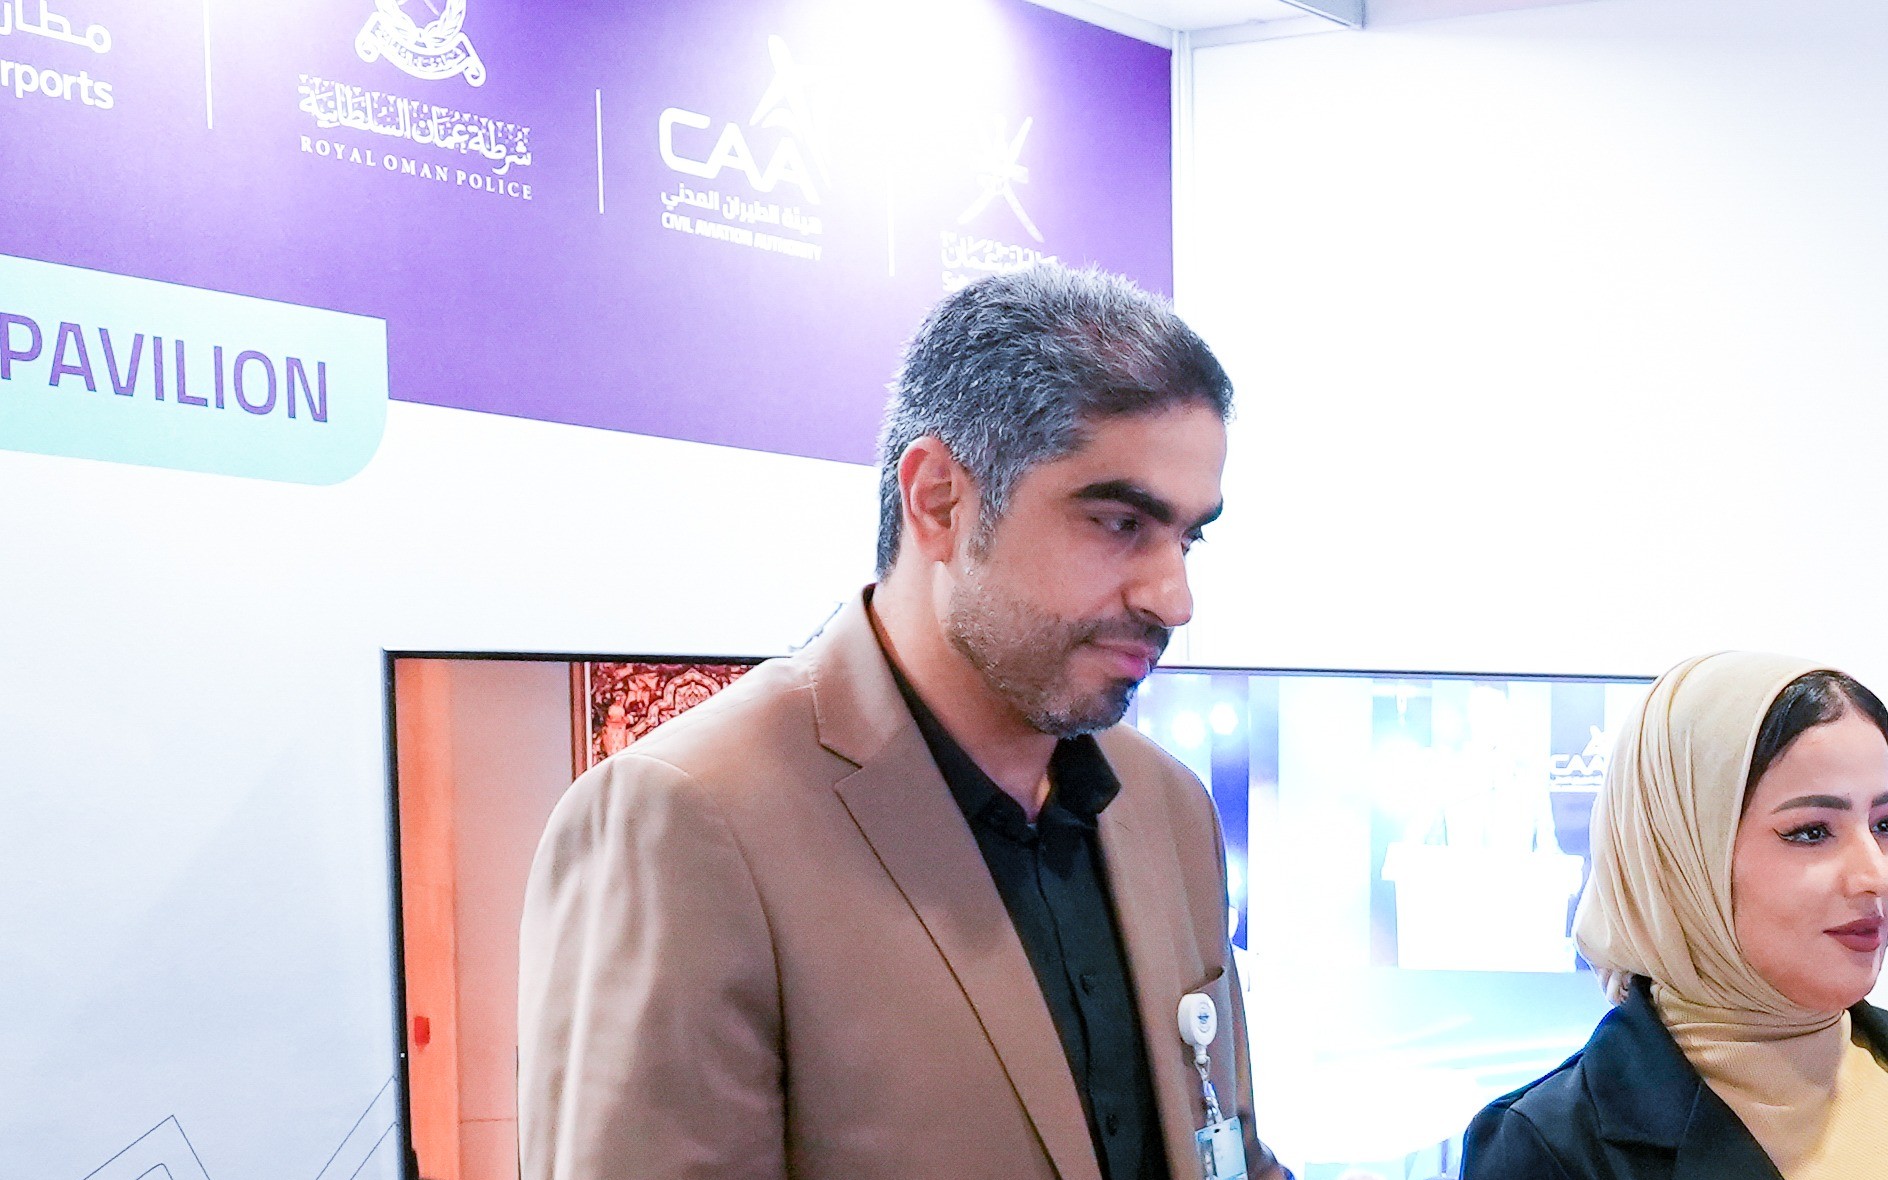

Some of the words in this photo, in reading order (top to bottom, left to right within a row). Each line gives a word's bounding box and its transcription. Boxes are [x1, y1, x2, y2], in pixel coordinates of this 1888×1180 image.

[300, 135, 377, 167] ROYAL
[383, 154, 449, 183] OMAN
[455, 169, 534, 201] POLICE
[658, 107, 822, 205] CAA
[660, 182, 720, 211] المدني
[721, 195, 780, 225] الطيران
[781, 206, 823, 236] هيئة
[660, 212, 695, 234] CIVIL
[694, 219, 754, 248] AVIATION
[753, 232, 824, 261] AUTHORITY
[0, 312, 329, 424] PAVILION
